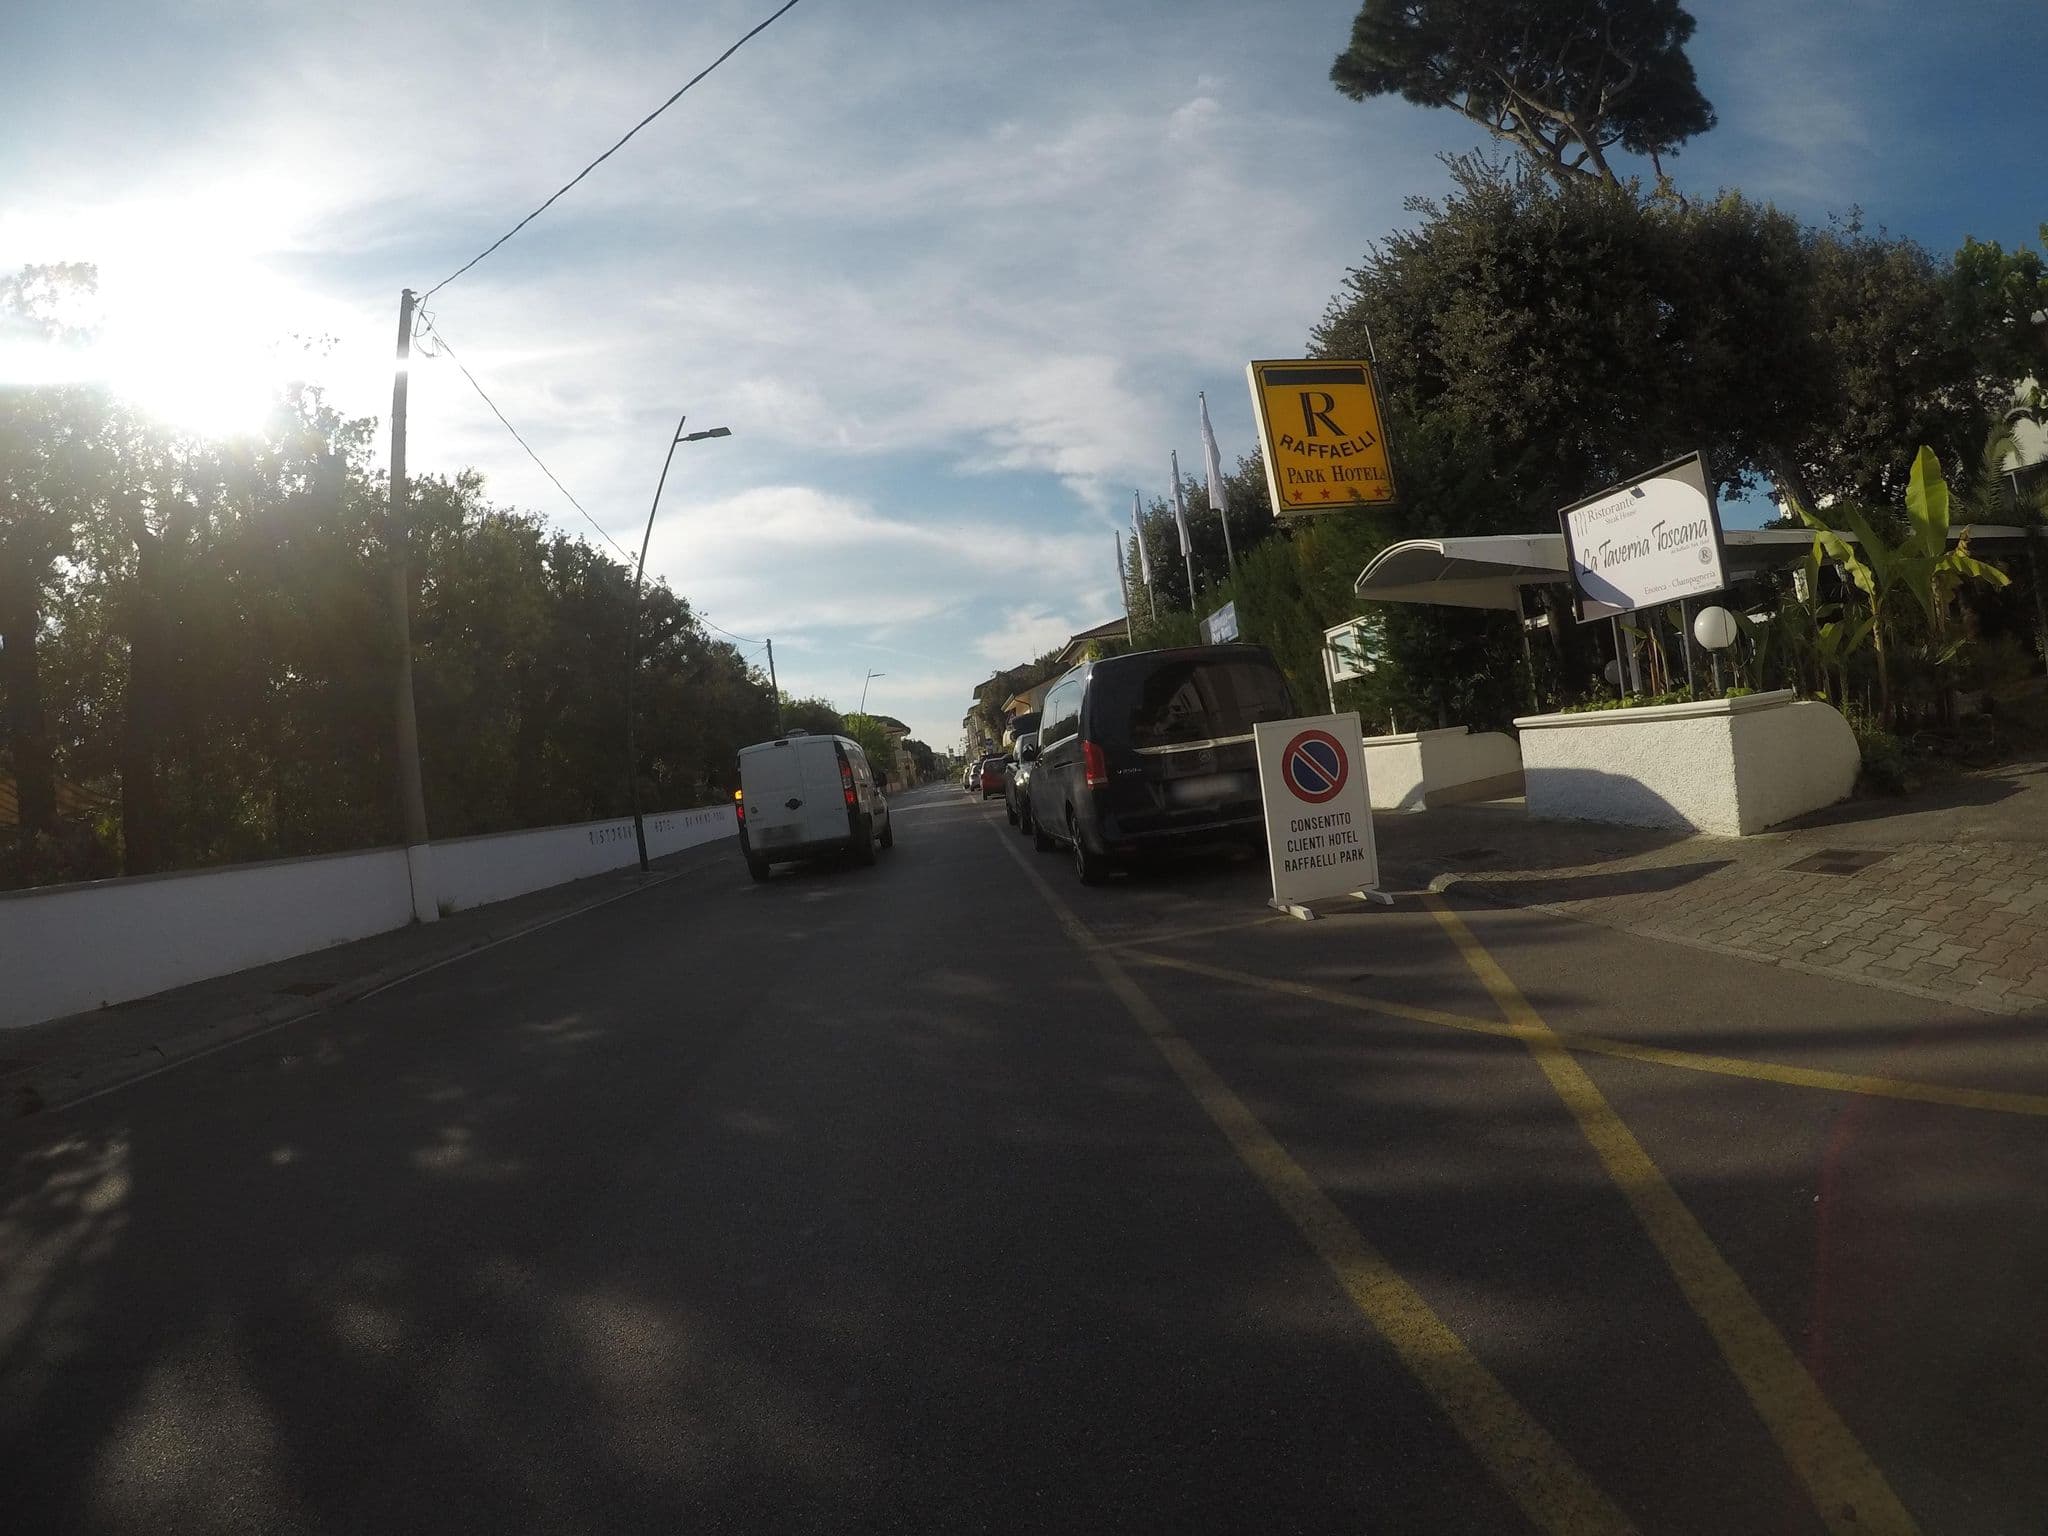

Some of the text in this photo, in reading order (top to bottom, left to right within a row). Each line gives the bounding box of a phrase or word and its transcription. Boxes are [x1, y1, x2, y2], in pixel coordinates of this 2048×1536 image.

[1299, 391, 1348, 437] R
[1280, 431, 1377, 459] RAFFAELLI
[1587, 497, 1635, 522] Ristorante
[1582, 548, 1598, 576] La
[1599, 538, 1650, 569] Taverna
[1651, 519, 1708, 551] Toscana
[1290, 812, 1351, 833] CONSENTITO
[1287, 830, 1358, 853] CLIENTI HOTEL
[1284, 848, 1365, 872] RAFFAELLI PARK
